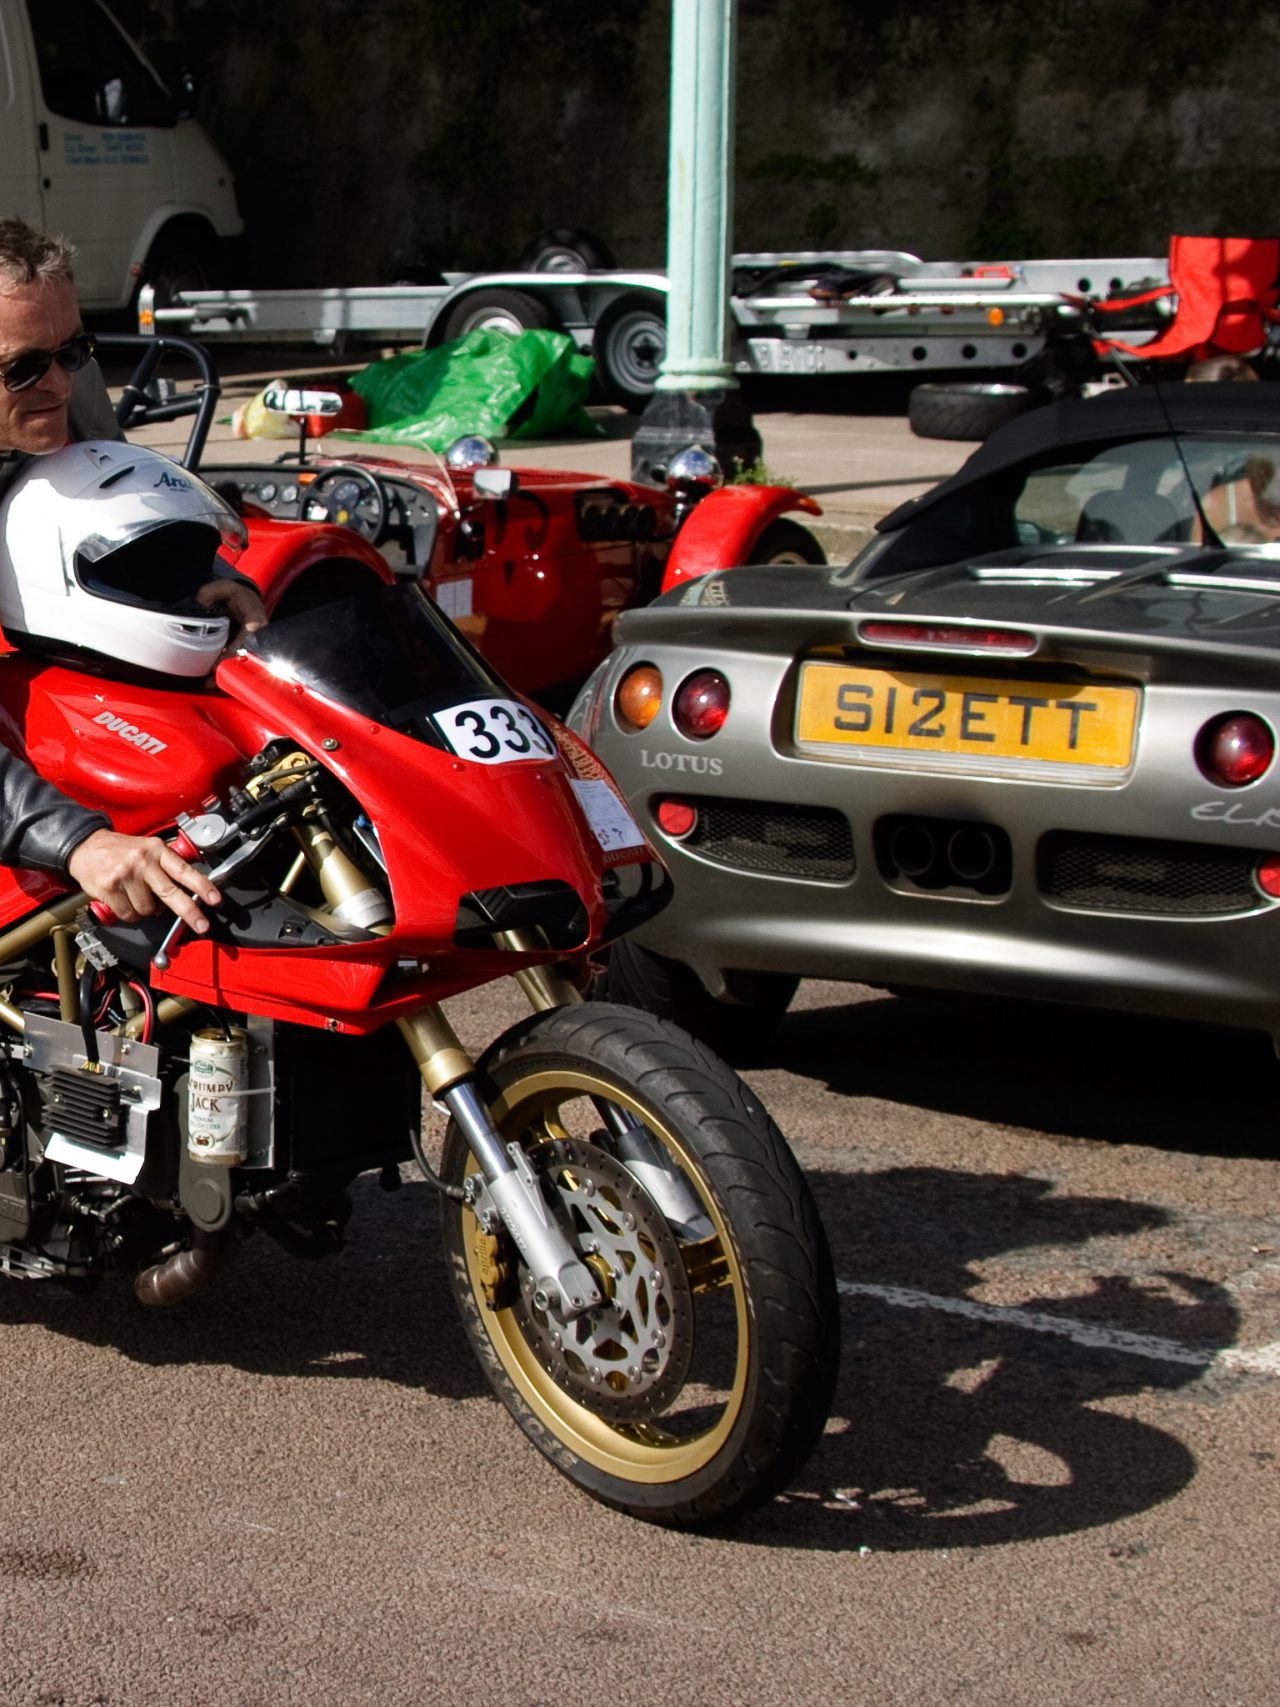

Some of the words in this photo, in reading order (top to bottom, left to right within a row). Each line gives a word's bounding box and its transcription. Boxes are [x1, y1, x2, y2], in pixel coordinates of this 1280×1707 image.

[92, 711, 168, 755] DUCATI
[454, 705, 555, 759] 333
[640, 749, 724, 776] LOTUS
[191, 1093, 222, 1113] JACK
